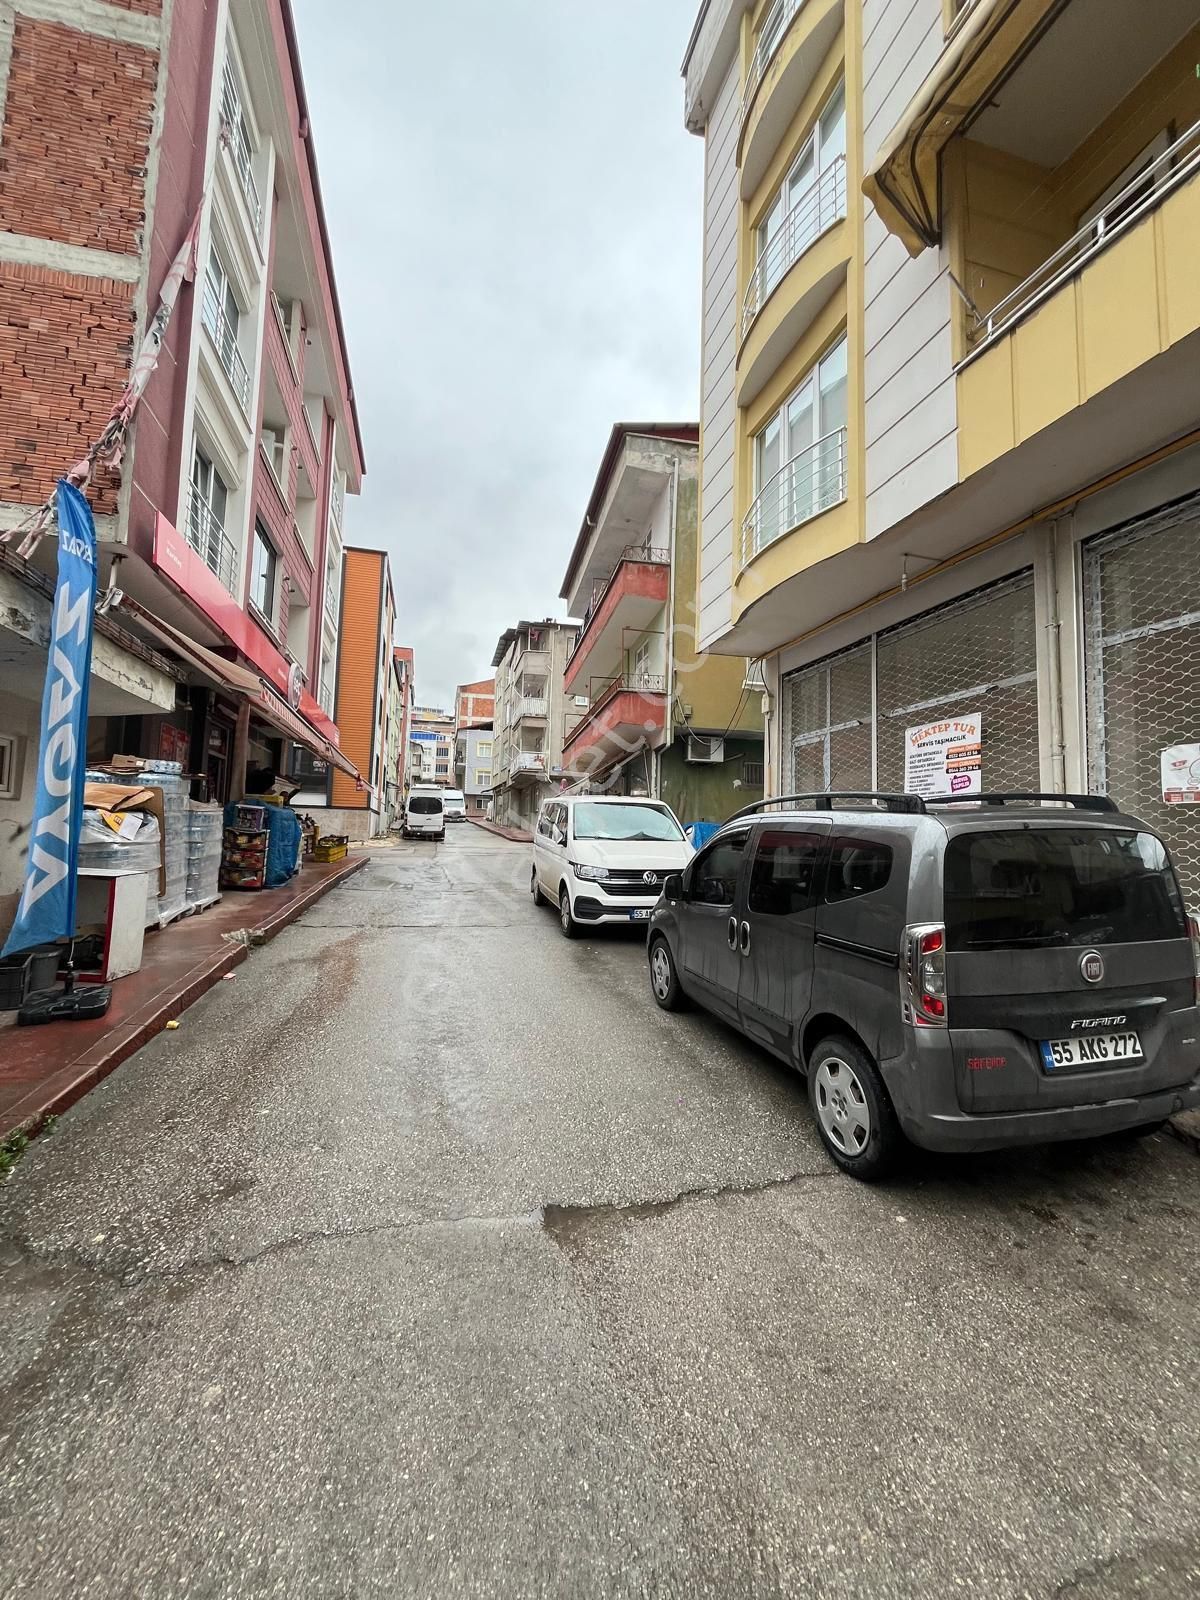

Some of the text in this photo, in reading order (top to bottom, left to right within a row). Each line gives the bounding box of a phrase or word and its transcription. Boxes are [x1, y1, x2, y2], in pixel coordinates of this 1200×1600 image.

[911, 723, 951, 746] MEKTEP
[953, 722, 976, 735] TUR
[1087, 962, 1101, 976] FIAT
[1070, 1015, 1127, 1029] FIORINO
[1050, 1034, 1140, 1064] 55 AKG 272
